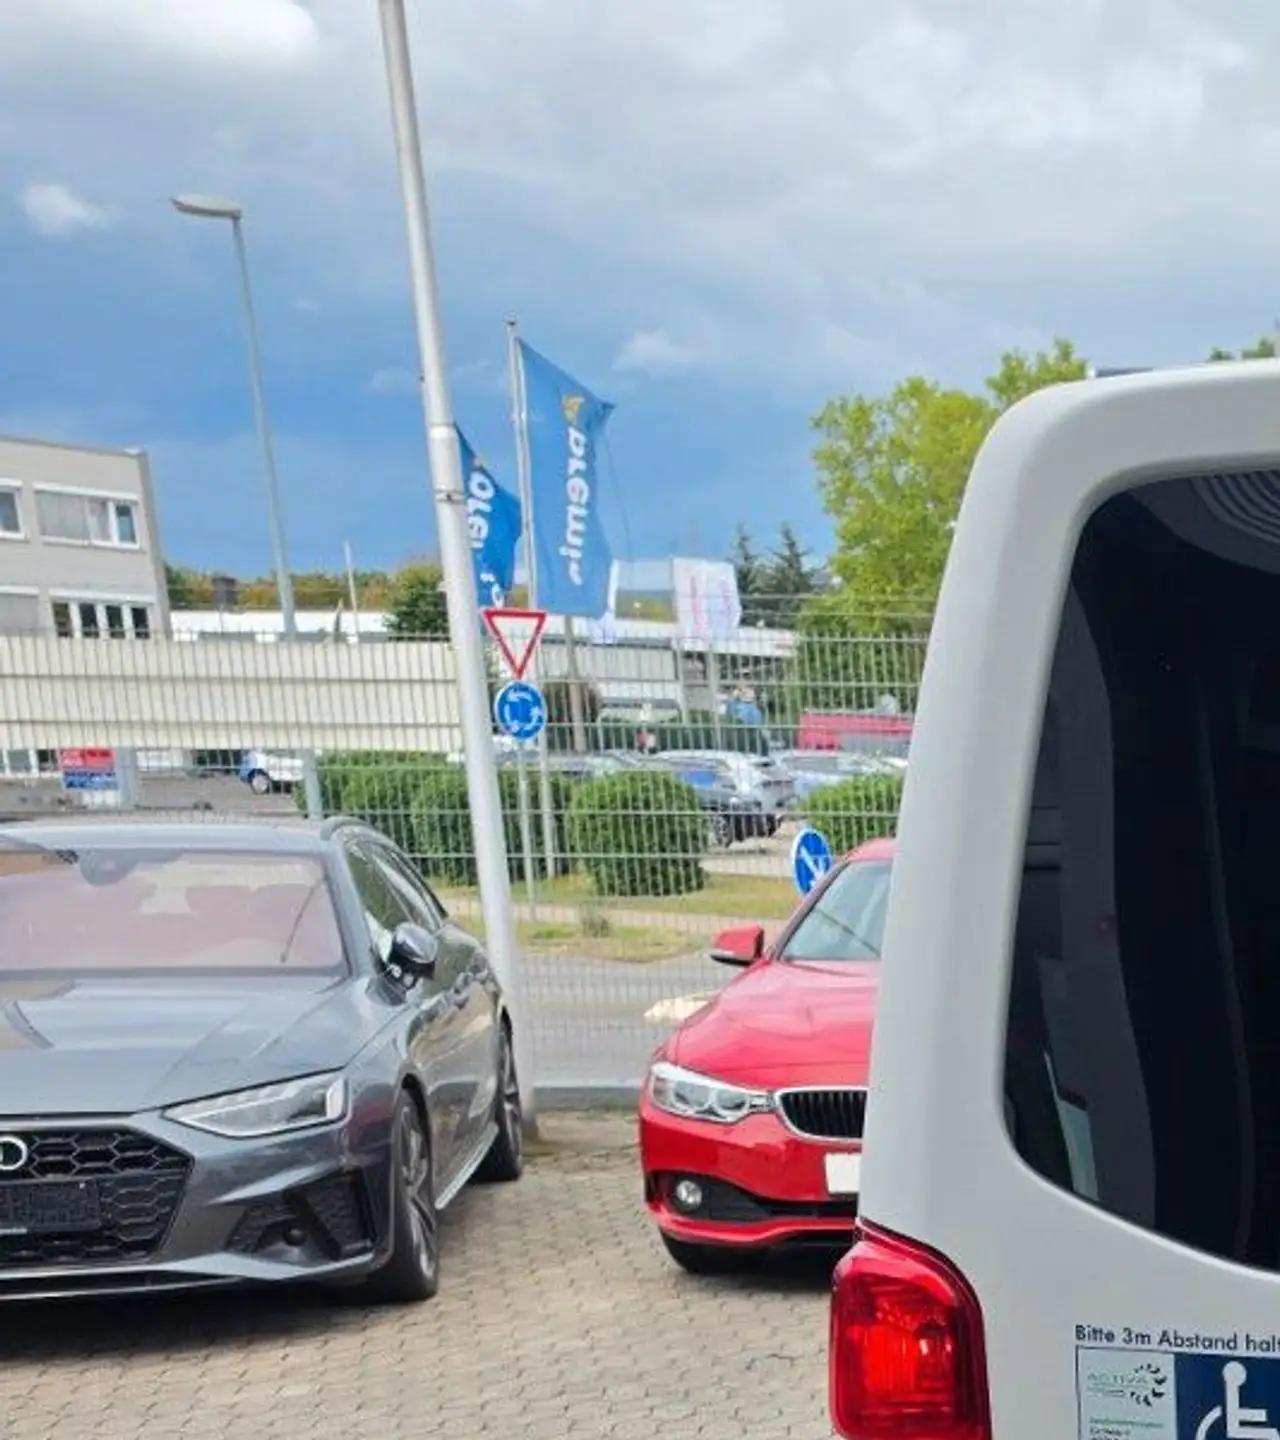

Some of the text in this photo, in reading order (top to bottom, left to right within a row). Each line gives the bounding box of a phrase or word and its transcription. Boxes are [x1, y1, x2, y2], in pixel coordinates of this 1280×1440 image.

[1075, 1324, 1115, 1342] Bitte
[1122, 1327, 1151, 1345] 3m
[1157, 1329, 1238, 1351] Abstand
